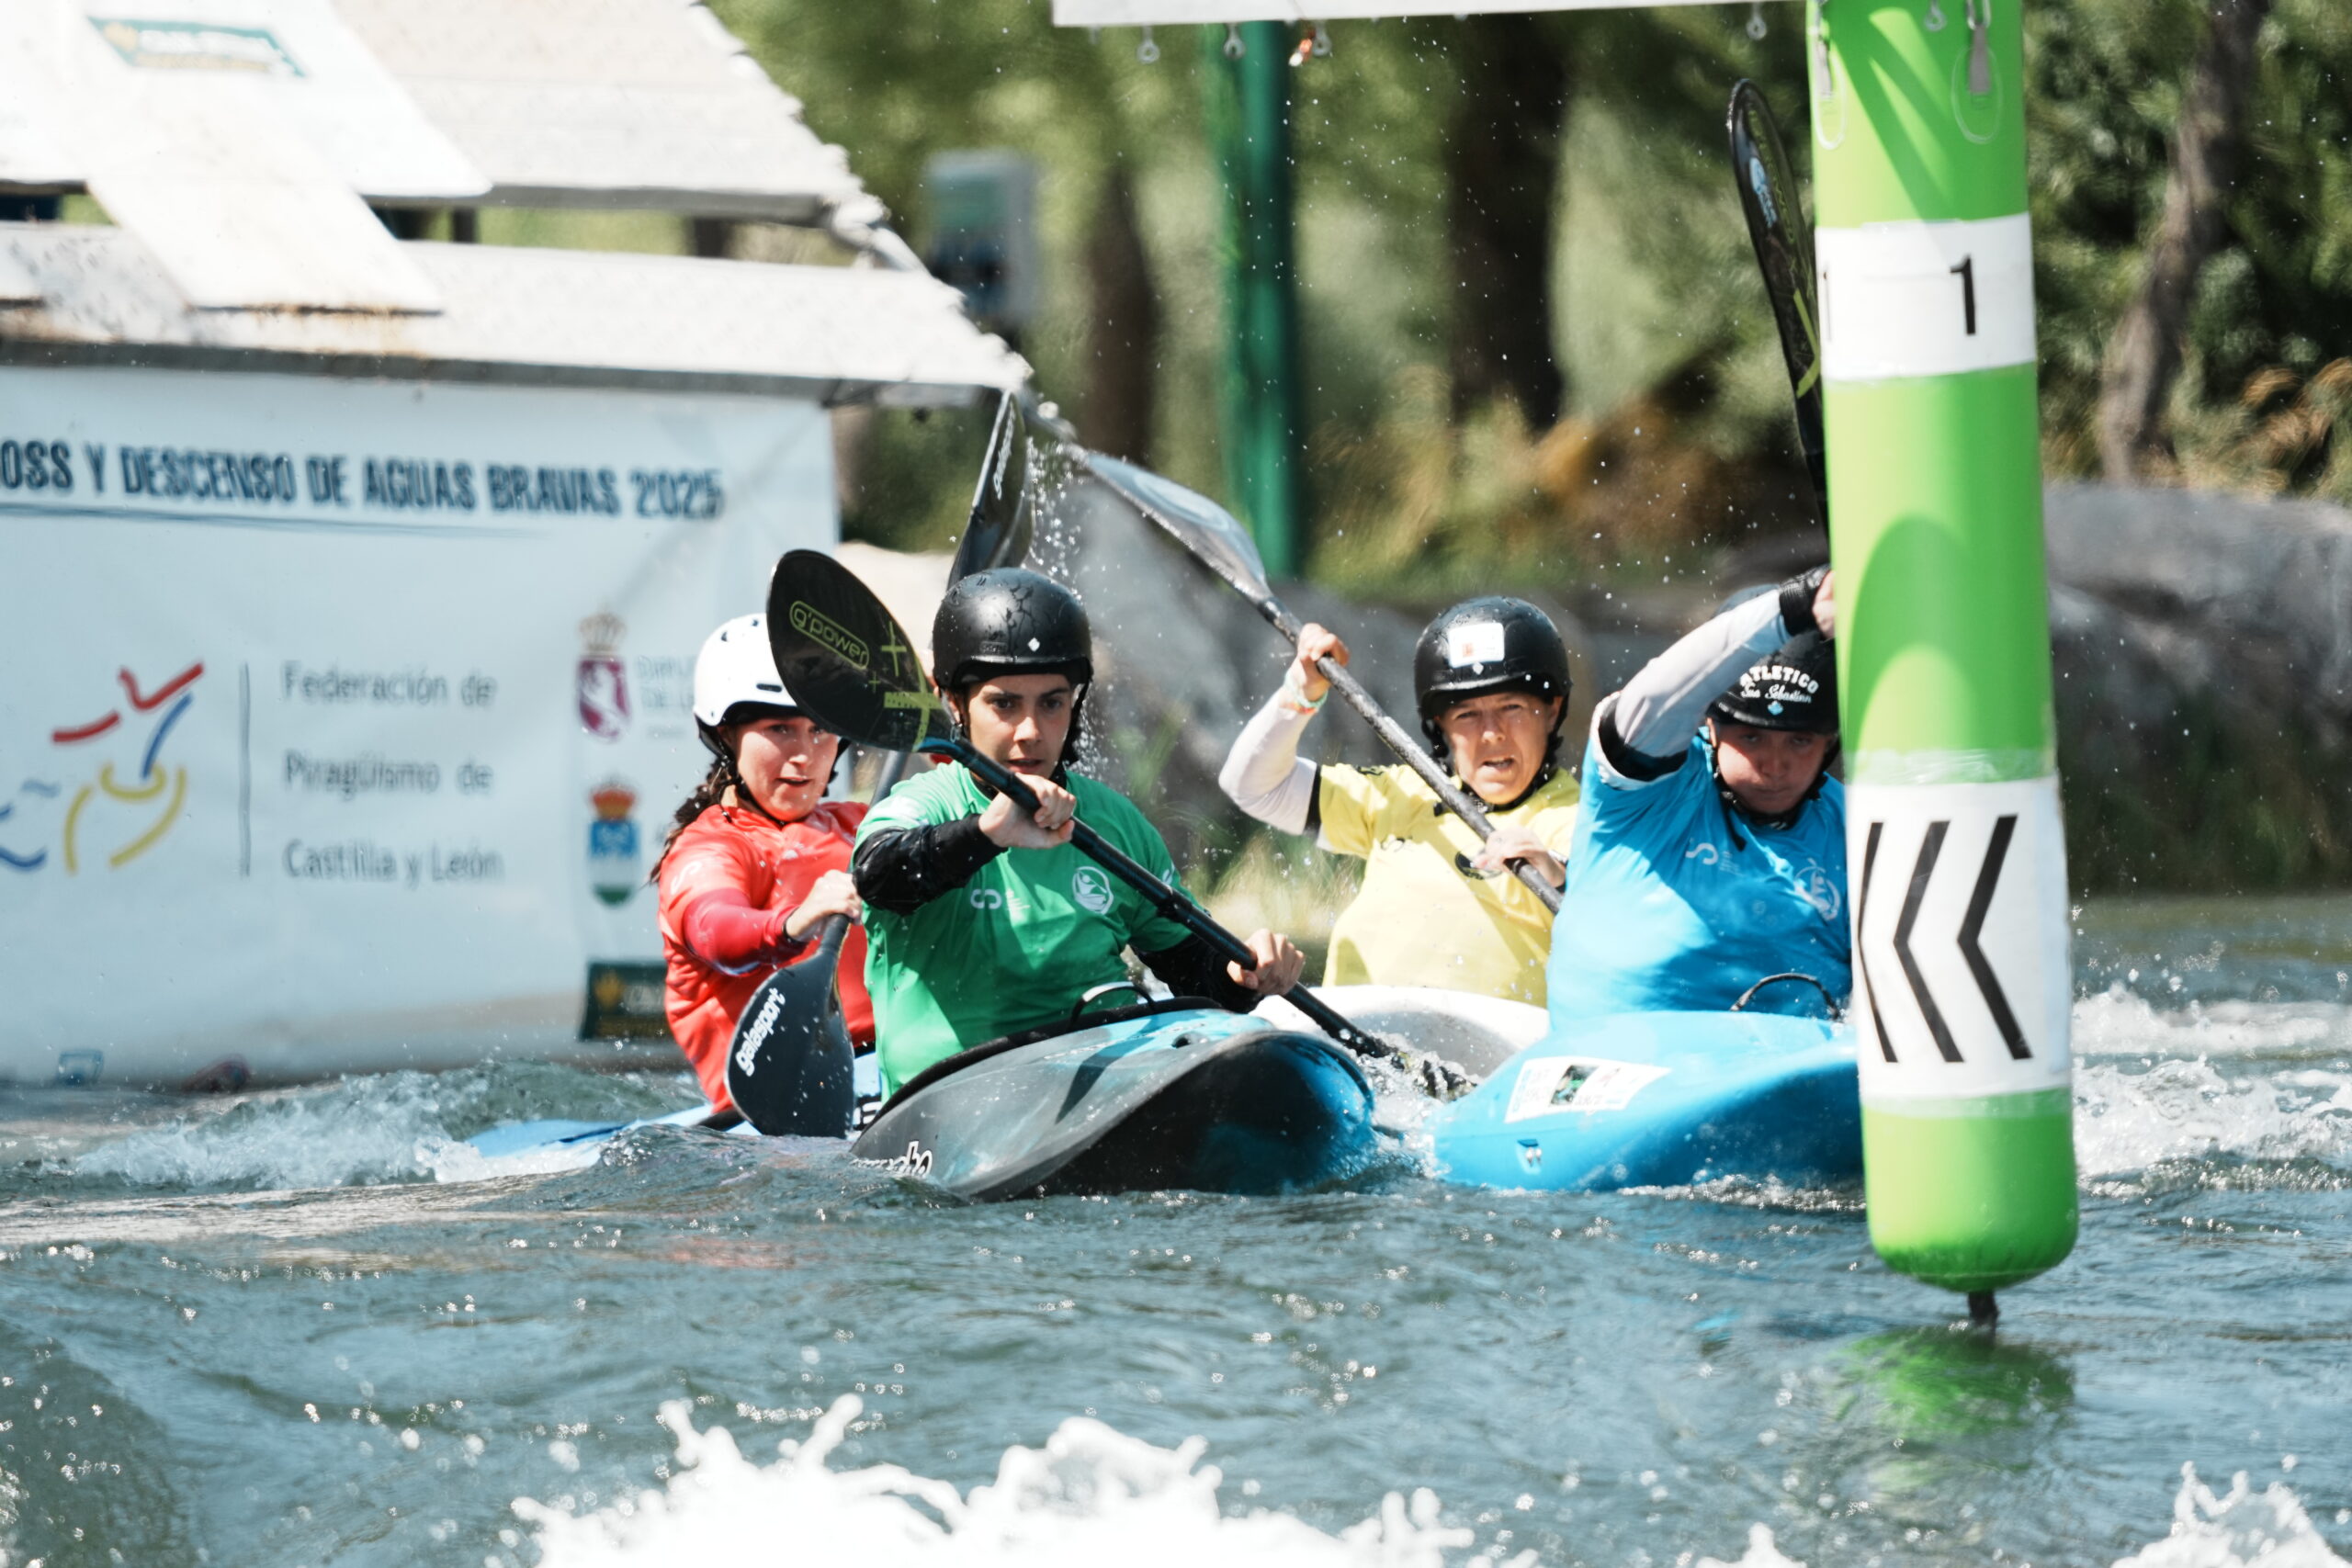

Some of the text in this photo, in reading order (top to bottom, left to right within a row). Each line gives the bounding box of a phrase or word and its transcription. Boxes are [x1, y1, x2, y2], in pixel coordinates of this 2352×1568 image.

[1951, 255, 1976, 335] 1
[0, 439, 726, 521] OSS Y DESCENSO DE AGUAS BRAVAS 2025
[281, 660, 499, 706] Federación de
[1739, 665, 1819, 694] ATLETICO
[458, 756, 495, 795] de
[282, 838, 504, 891] Castilla y León
[736, 987, 786, 1077] galasport
